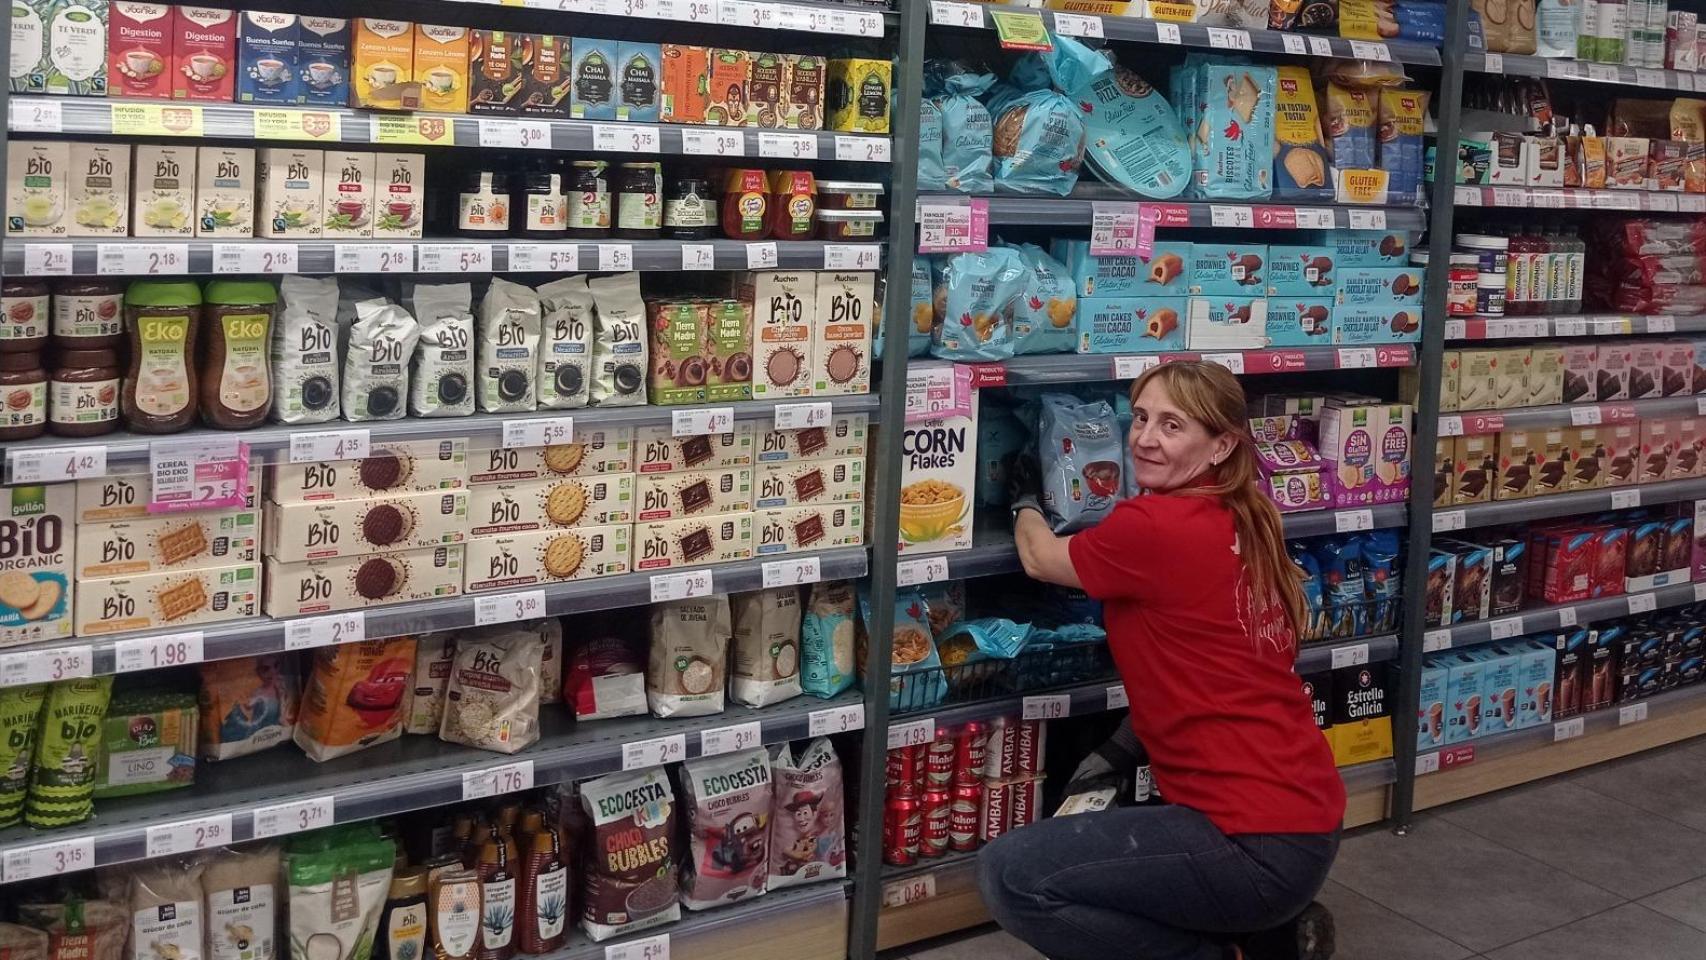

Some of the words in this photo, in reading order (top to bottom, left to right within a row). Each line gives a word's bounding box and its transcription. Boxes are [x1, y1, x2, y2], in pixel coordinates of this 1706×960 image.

[1063, 2, 1113, 14] GLUTEN-FREE
[1154, 6, 1192, 17] GLUTEN-FREE
[120, 27, 162, 38] Digestion
[185, 31, 225, 42] Digestion
[246, 36, 270, 44] Buenos
[272, 38, 294, 46] Sueños
[585, 65, 604, 74] CHAI
[630, 68, 648, 76] CHAI
[1096, 86, 1122, 104] PIZZA
[1284, 112, 1307, 120] TOSTAS
[1226, 145, 1234, 184] BISCOTES
[1353, 184, 1371, 196] FREE
[1114, 257, 1136, 267] CAKES
[1196, 260, 1226, 270] BROWNIES
[1271, 262, 1300, 272] BROWNIES
[1111, 266, 1136, 277] CACAO
[1093, 313, 1108, 322] MINI
[1111, 313, 1132, 322] CAKES
[1267, 312, 1296, 321] BROWNIES
[228, 321, 264, 338] Eko
[676, 322, 695, 330] Tierra
[721, 319, 740, 328] Tierra
[1107, 322, 1132, 334] CACAO
[143, 322, 183, 340] Eko
[674, 332, 695, 340] Madre
[720, 328, 740, 337] Madre
[902, 427, 966, 456] CORN
[1384, 437, 1407, 449] FREE
[157, 460, 188, 469] CEREAL
[910, 453, 955, 471] Flakes
[172, 468, 188, 476] EKO
[12, 502, 44, 515] gullón
[150, 642, 188, 667] 1.98
[1347, 687, 1384, 705] Estrella
[1348, 702, 1382, 718] Galicia
[1002, 726, 1015, 777] AMBAR
[127, 760, 155, 772] LINO
[703, 765, 769, 797] ECOCESTA
[598, 782, 666, 818] ECOCESTA
[708, 798, 726, 810] CHOCO
[726, 792, 750, 805] BUBBLES
[988, 789, 1003, 840] AMBAR
[606, 829, 643, 852] CHOCO
[607, 837, 669, 873] BUBBLES
